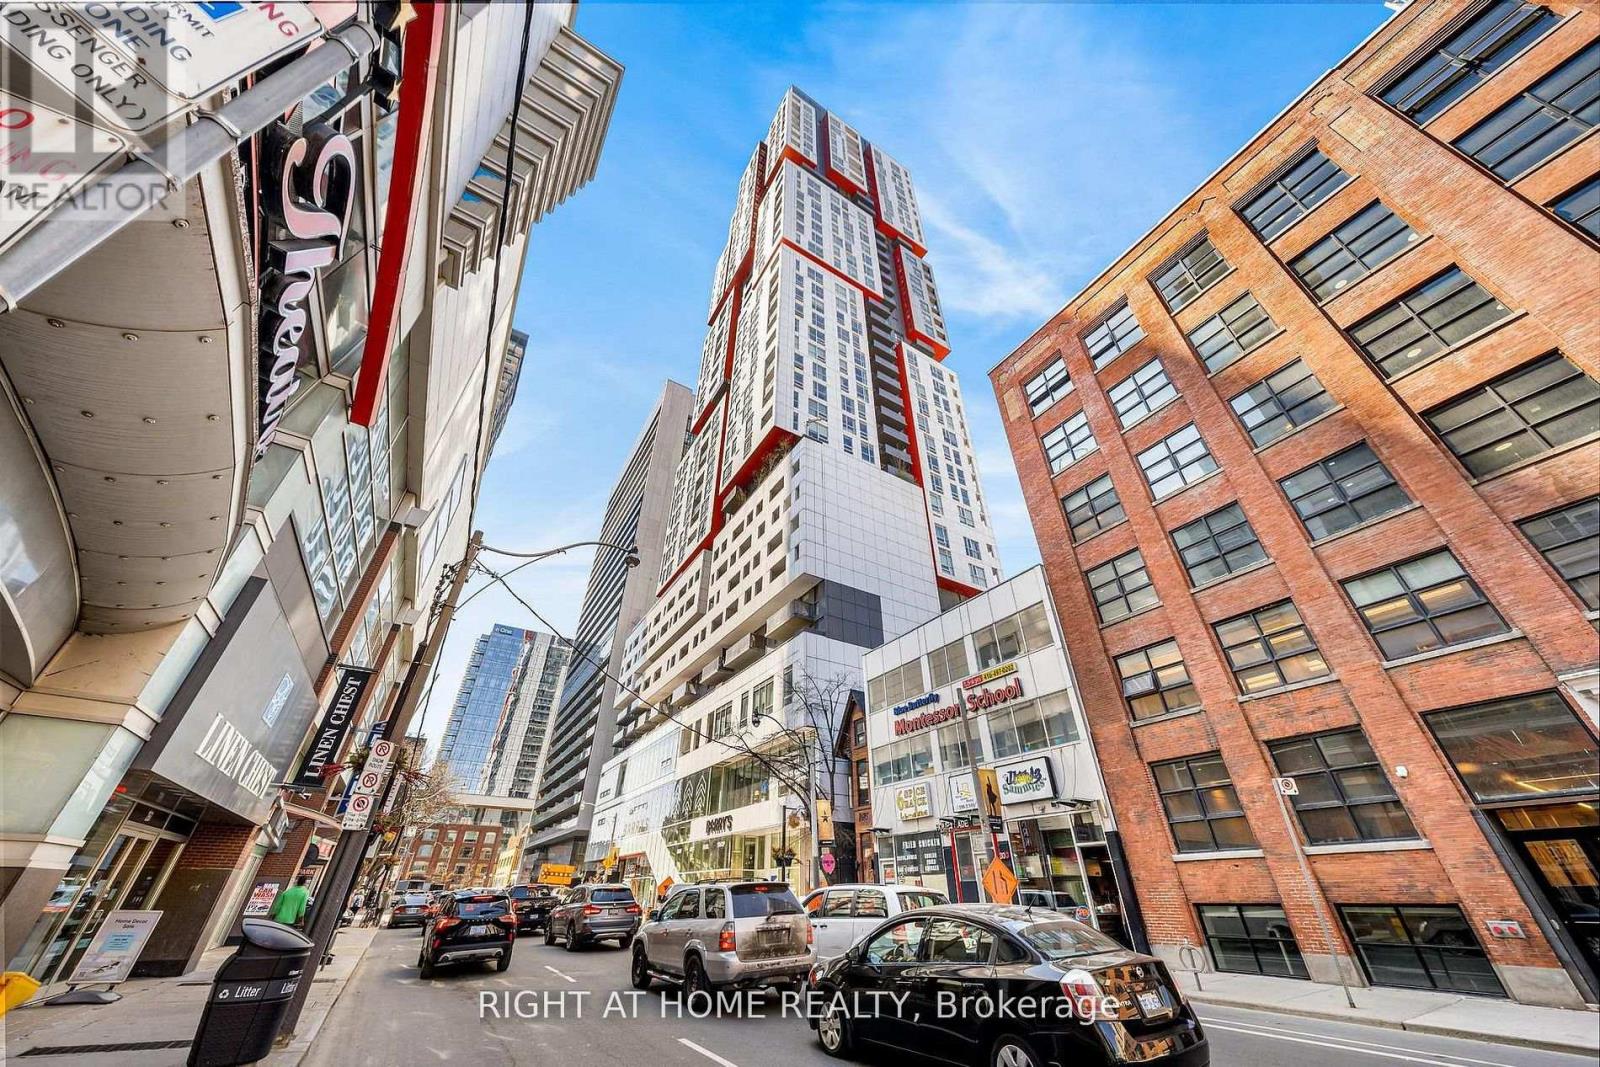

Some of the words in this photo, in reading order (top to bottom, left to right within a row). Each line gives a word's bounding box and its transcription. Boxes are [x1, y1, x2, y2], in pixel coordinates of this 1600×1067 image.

[2, 8, 72, 60] DING
[119, 4, 193, 62] DING
[171, 3, 215, 39] RMIT
[303, 727, 338, 780] LINEN
[330, 676, 362, 726] CHEST
[894, 703, 961, 737] Montessor
[966, 677, 1024, 713] School
[193, 712, 252, 780] LINEN
[238, 749, 278, 800] CHEST
[234, 985, 261, 998] Litter
